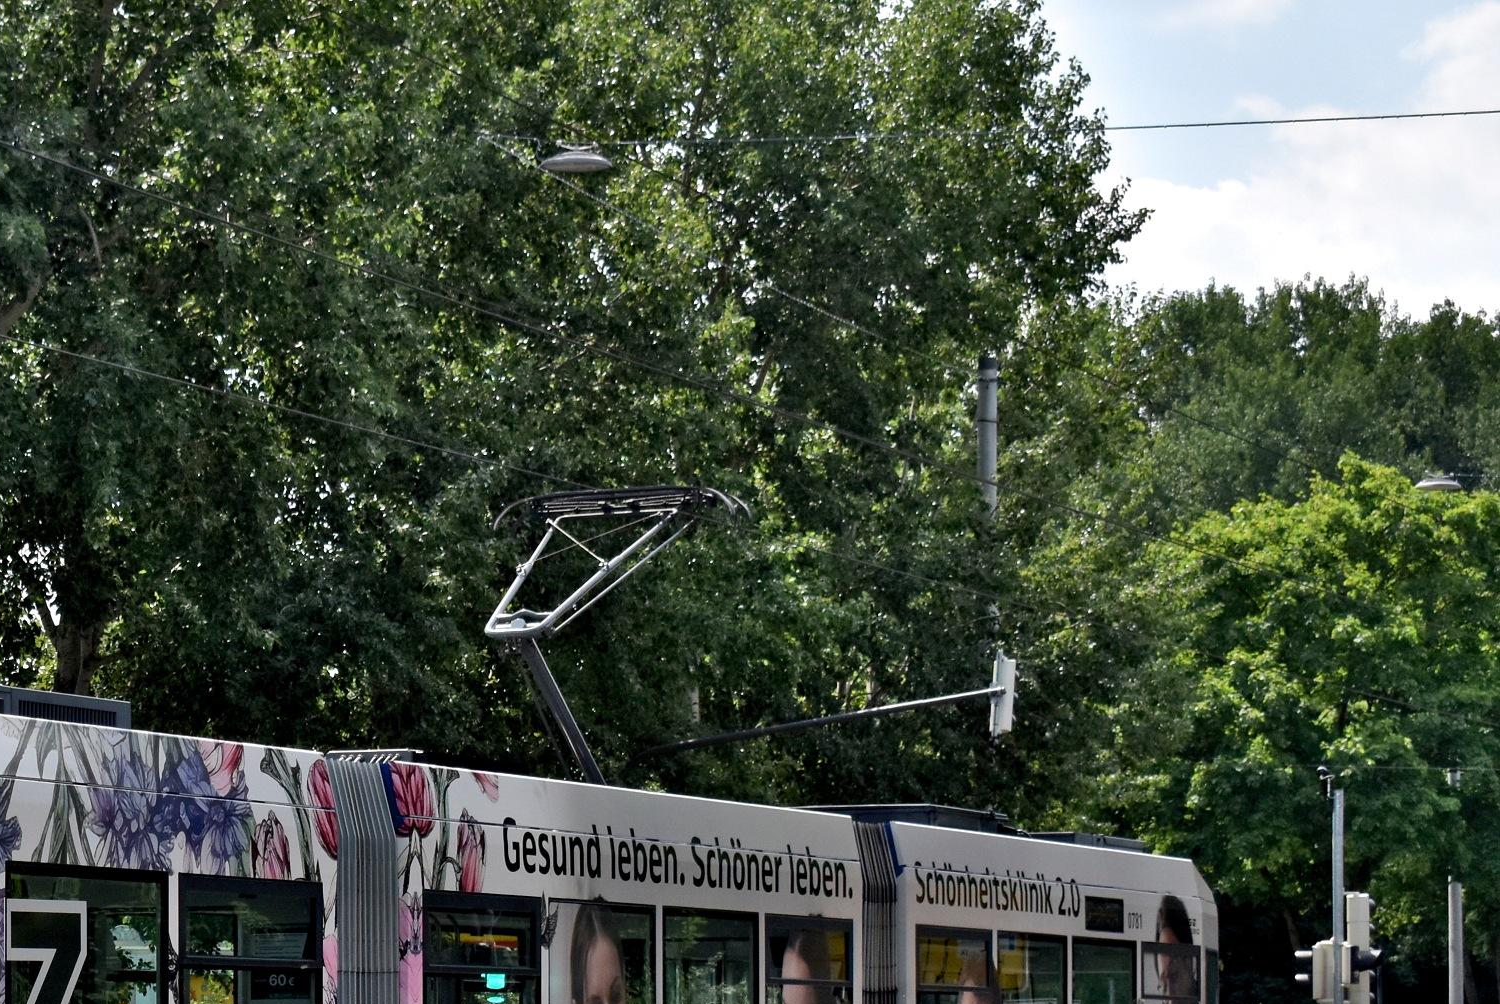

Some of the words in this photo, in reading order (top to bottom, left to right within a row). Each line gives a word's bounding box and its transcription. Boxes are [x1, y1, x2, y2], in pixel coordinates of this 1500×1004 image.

[503, 817, 601, 878] Gesund
[606, 826, 685, 886] leben.
[691, 837, 782, 893] Schöner
[787, 844, 854, 899] leben.
[914, 861, 1053, 914] Schönheitsklinik
[1056, 877, 1081, 917] 2.0
[1127, 912, 1143, 930] 0781
[269, 974, 287, 986] 60
